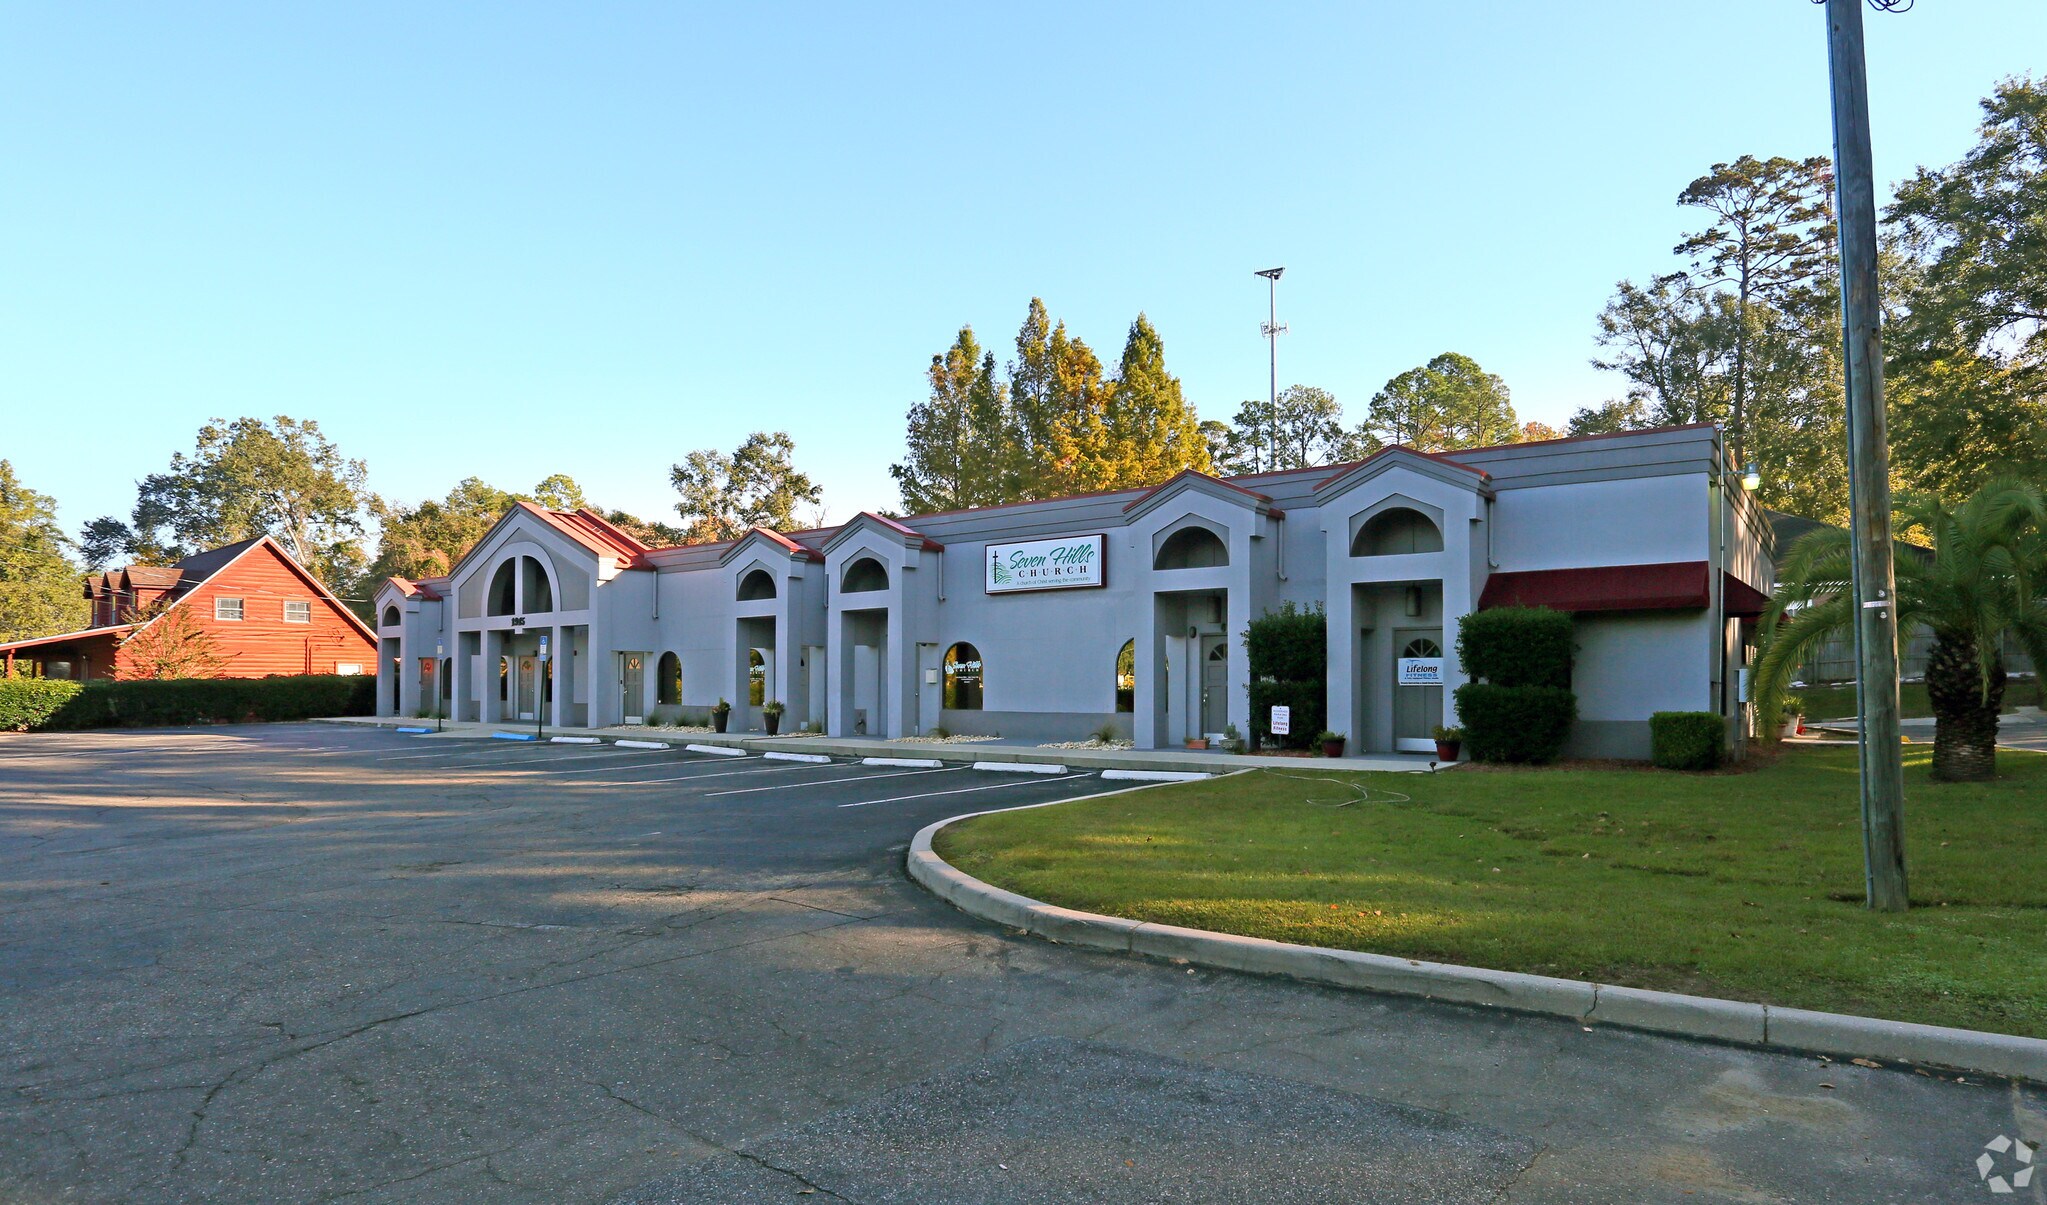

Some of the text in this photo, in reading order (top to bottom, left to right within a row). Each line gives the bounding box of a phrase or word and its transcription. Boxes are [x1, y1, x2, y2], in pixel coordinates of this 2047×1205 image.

[1009, 543, 1095, 570] Seven Hills
[1406, 664, 1438, 673] Lifelong
